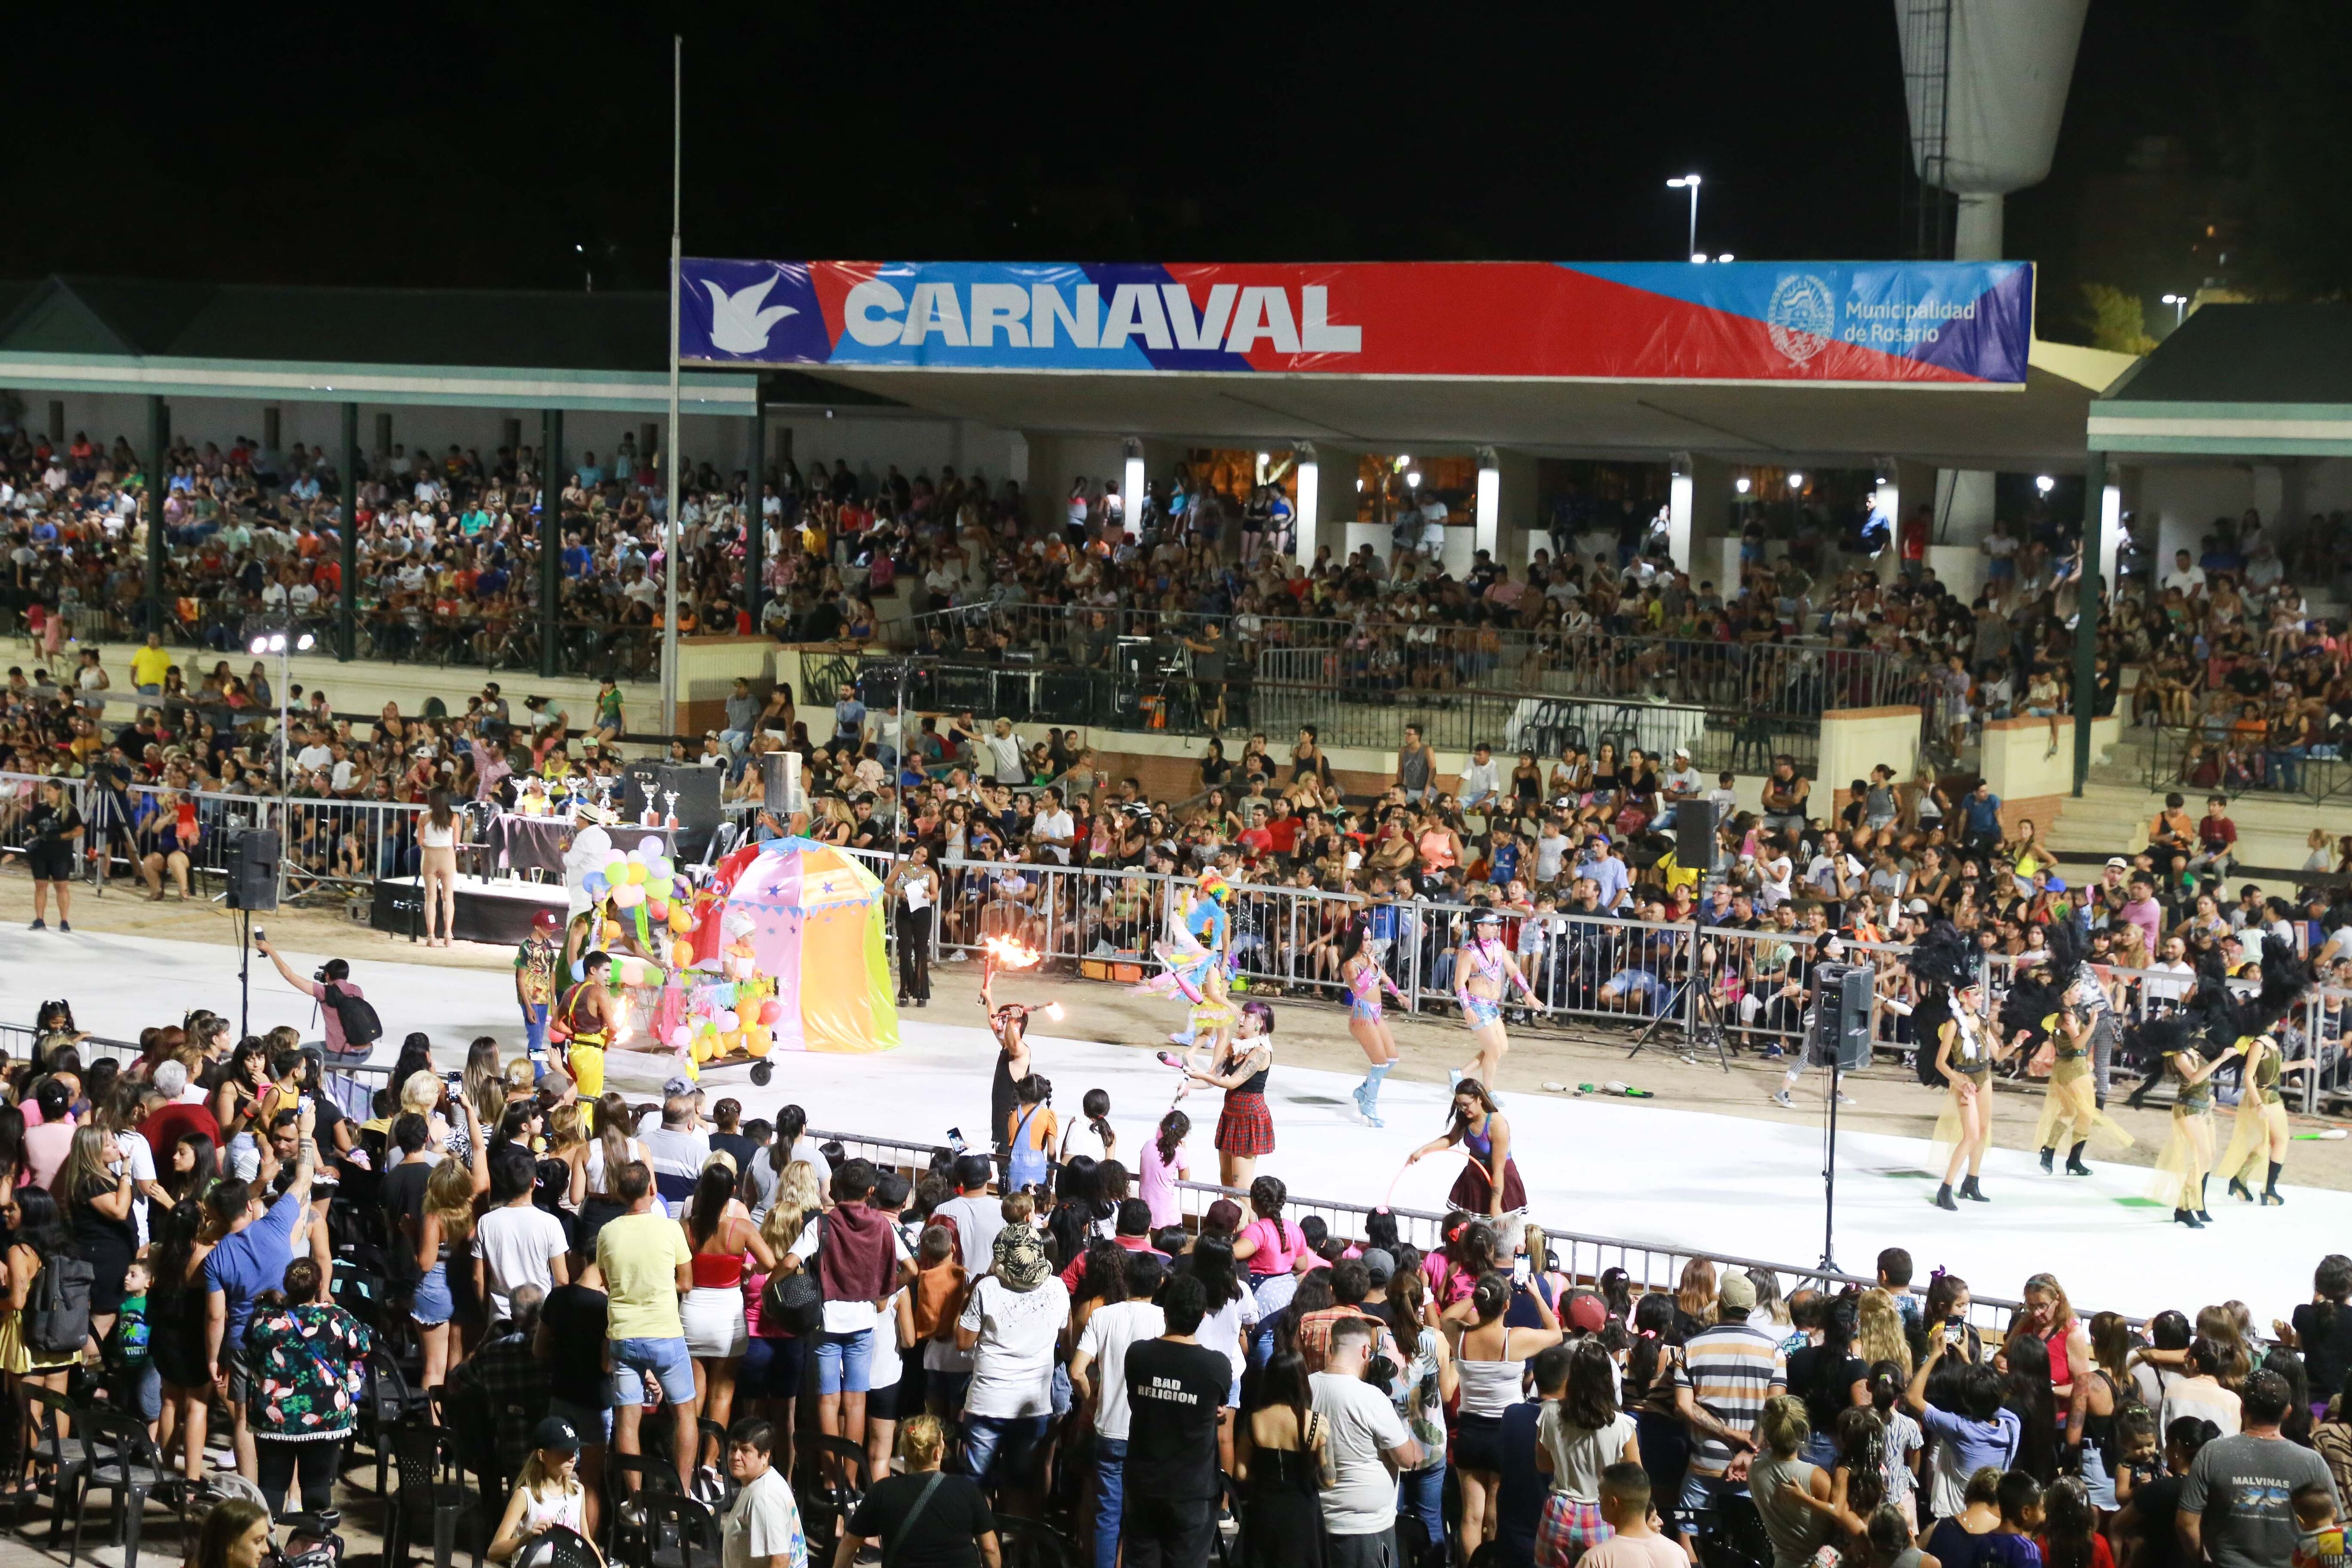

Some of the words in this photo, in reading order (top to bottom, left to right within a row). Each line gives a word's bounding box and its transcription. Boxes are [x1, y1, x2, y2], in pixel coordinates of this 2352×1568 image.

[844, 281, 1362, 353] CARNAVAL
[1845, 300, 1976, 323] Municipalidad
[1844, 324, 1867, 342] de
[1871, 325, 1939, 342] Rosario
[1152, 1376, 1181, 1391] BAD
[1137, 1385, 1198, 1405] RELIGION
[2232, 1476, 2290, 1488] MALVINAS
